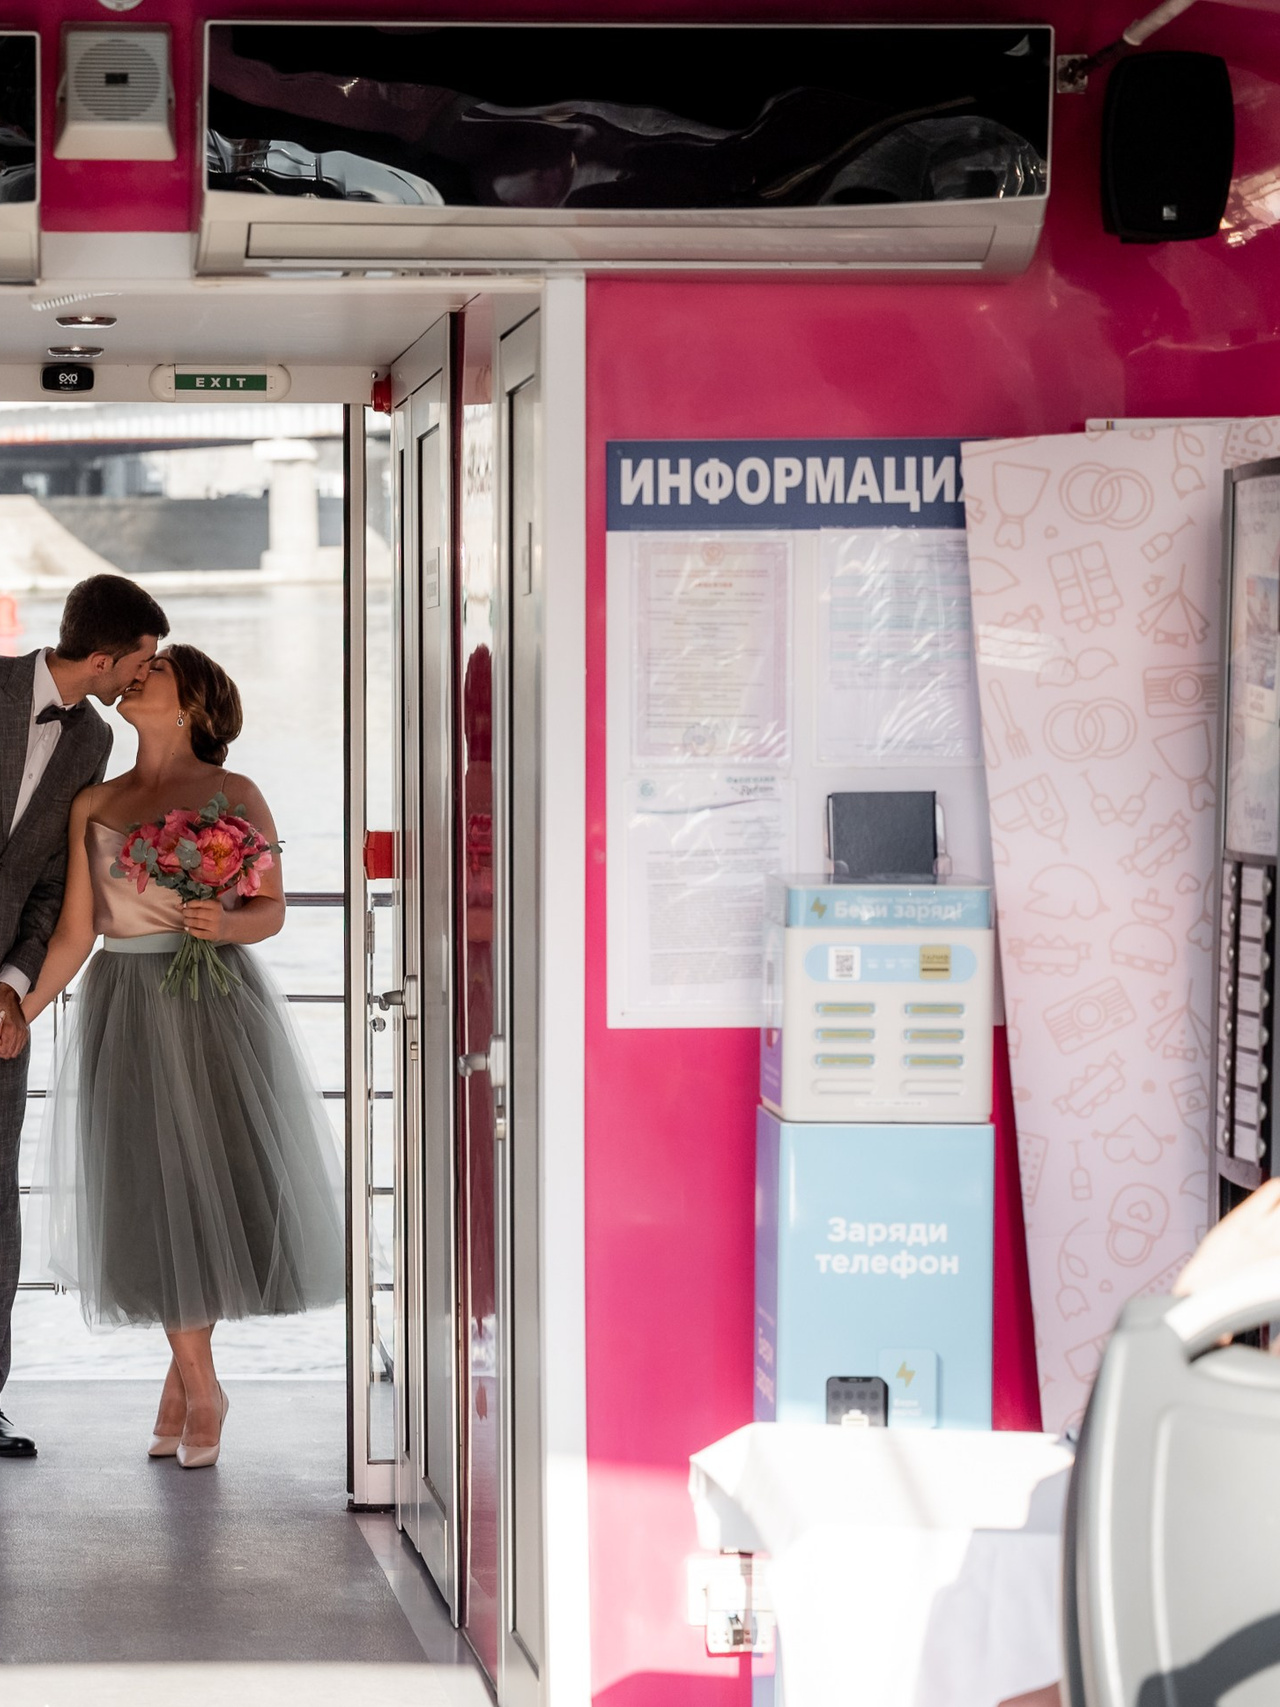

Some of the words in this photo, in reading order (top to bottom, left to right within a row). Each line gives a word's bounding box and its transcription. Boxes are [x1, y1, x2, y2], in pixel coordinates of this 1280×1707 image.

[195, 377, 247, 389] EXIT
[620, 456, 965, 513] ИНФОРМАЦИ
[827, 1216, 948, 1247] Заряди
[815, 1249, 960, 1280] телефон
